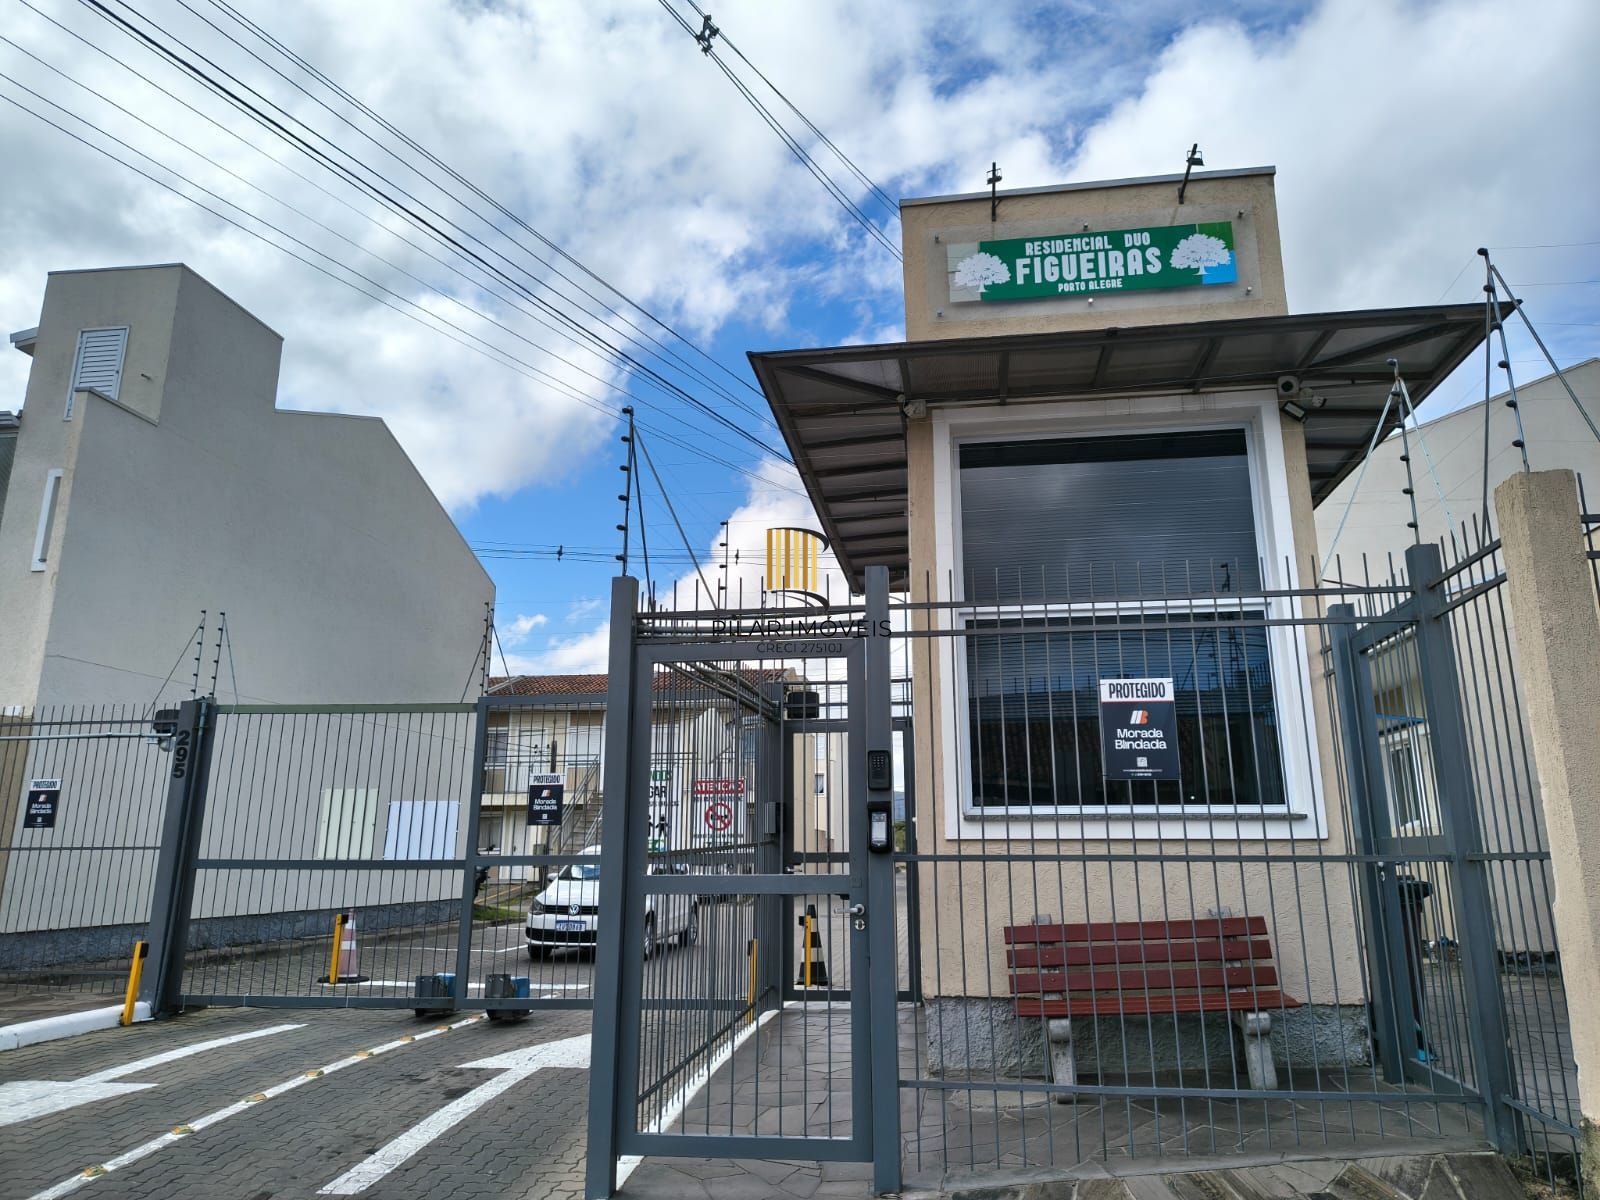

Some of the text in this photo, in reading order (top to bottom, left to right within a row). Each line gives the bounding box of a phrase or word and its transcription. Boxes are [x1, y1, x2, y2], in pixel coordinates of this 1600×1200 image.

[1025, 232, 1150, 256] RESIDENCIAL DUO
[1015, 247, 1162, 285] FIGUEIRAS
[1058, 278, 1123, 292] PORTO ALEGRE
[1109, 682, 1165, 699] PROTEGIDO
[1116, 728, 1163, 738] Morada
[1115, 739, 1167, 750] Blindada
[173, 730, 190, 778] 295
